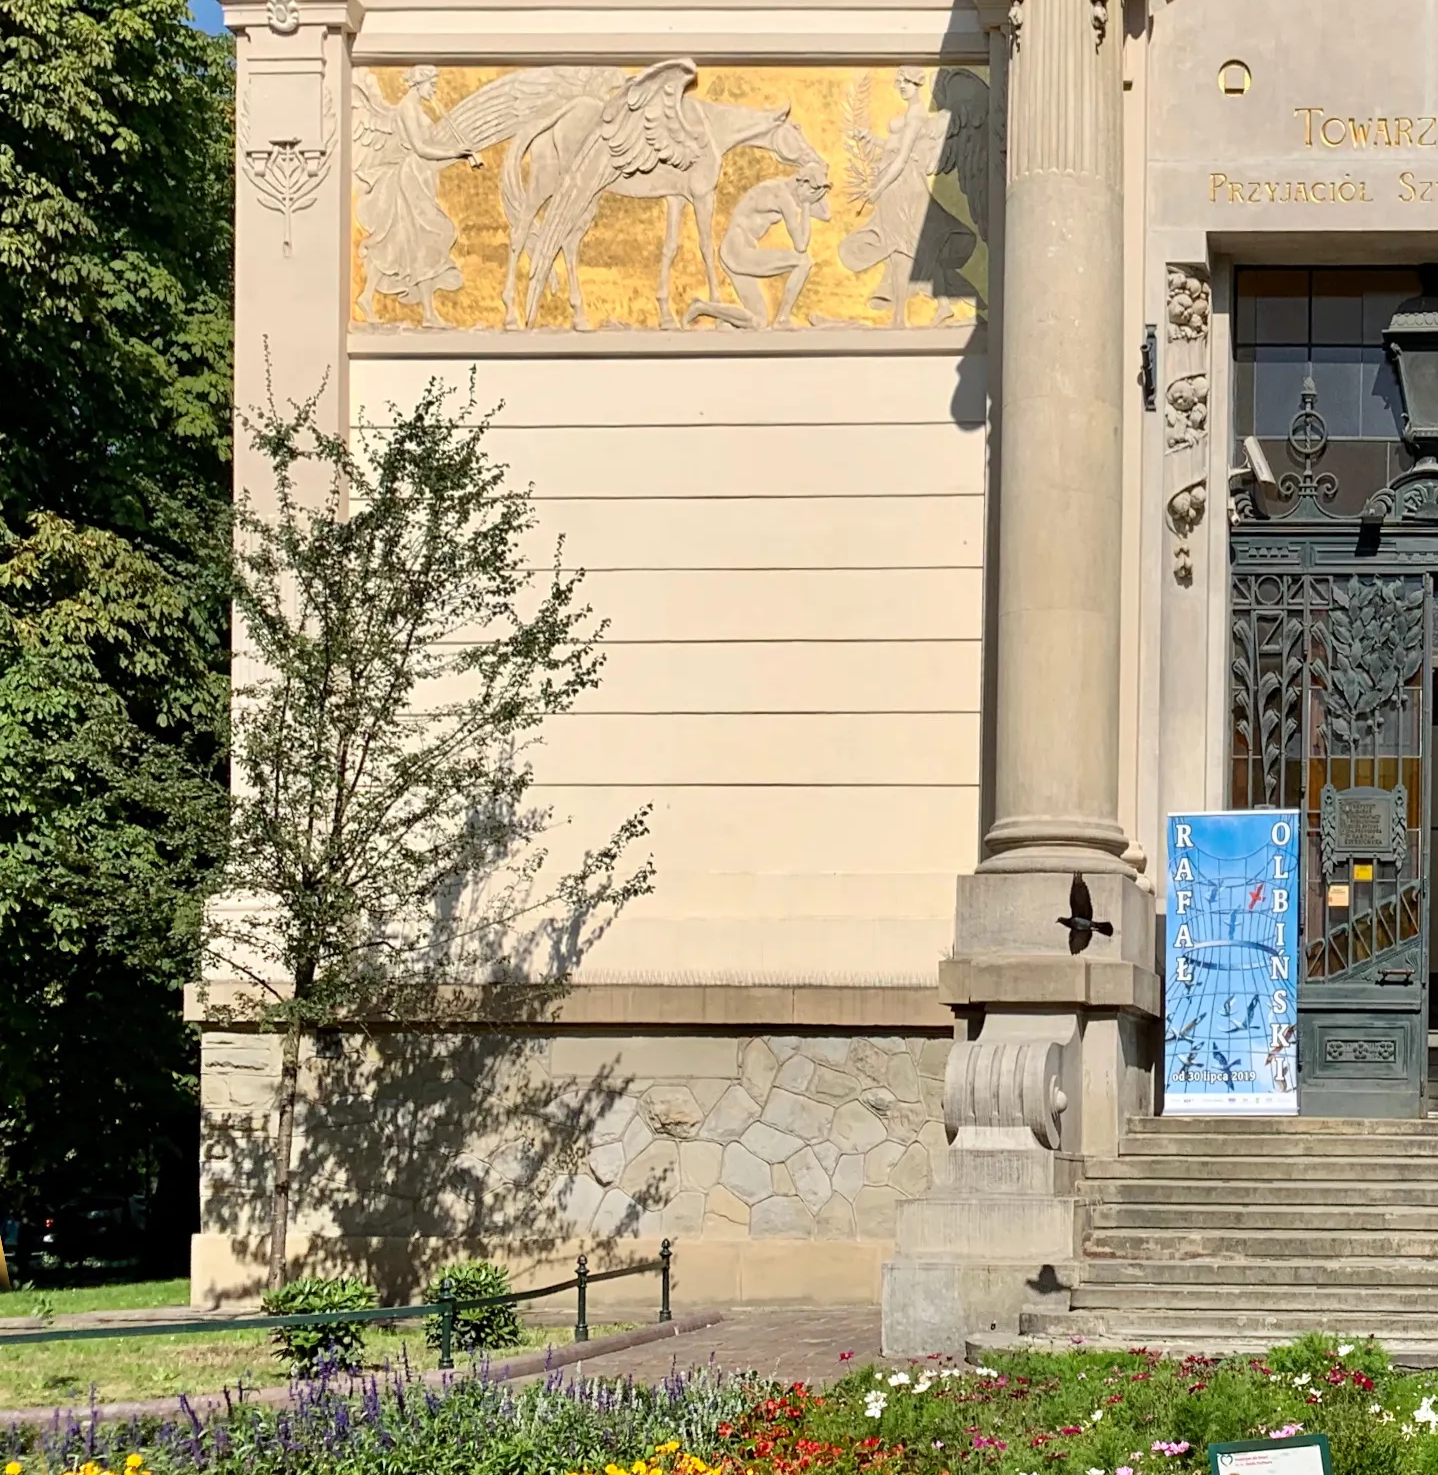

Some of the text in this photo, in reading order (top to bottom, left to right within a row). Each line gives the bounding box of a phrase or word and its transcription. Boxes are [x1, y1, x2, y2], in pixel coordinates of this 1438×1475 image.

[1173, 824, 1195, 982] RAFAŁ
[1269, 821, 1291, 1082] OLBIŃSKI
[1172, 1070, 1257, 1084] od 30 lipca 2019
